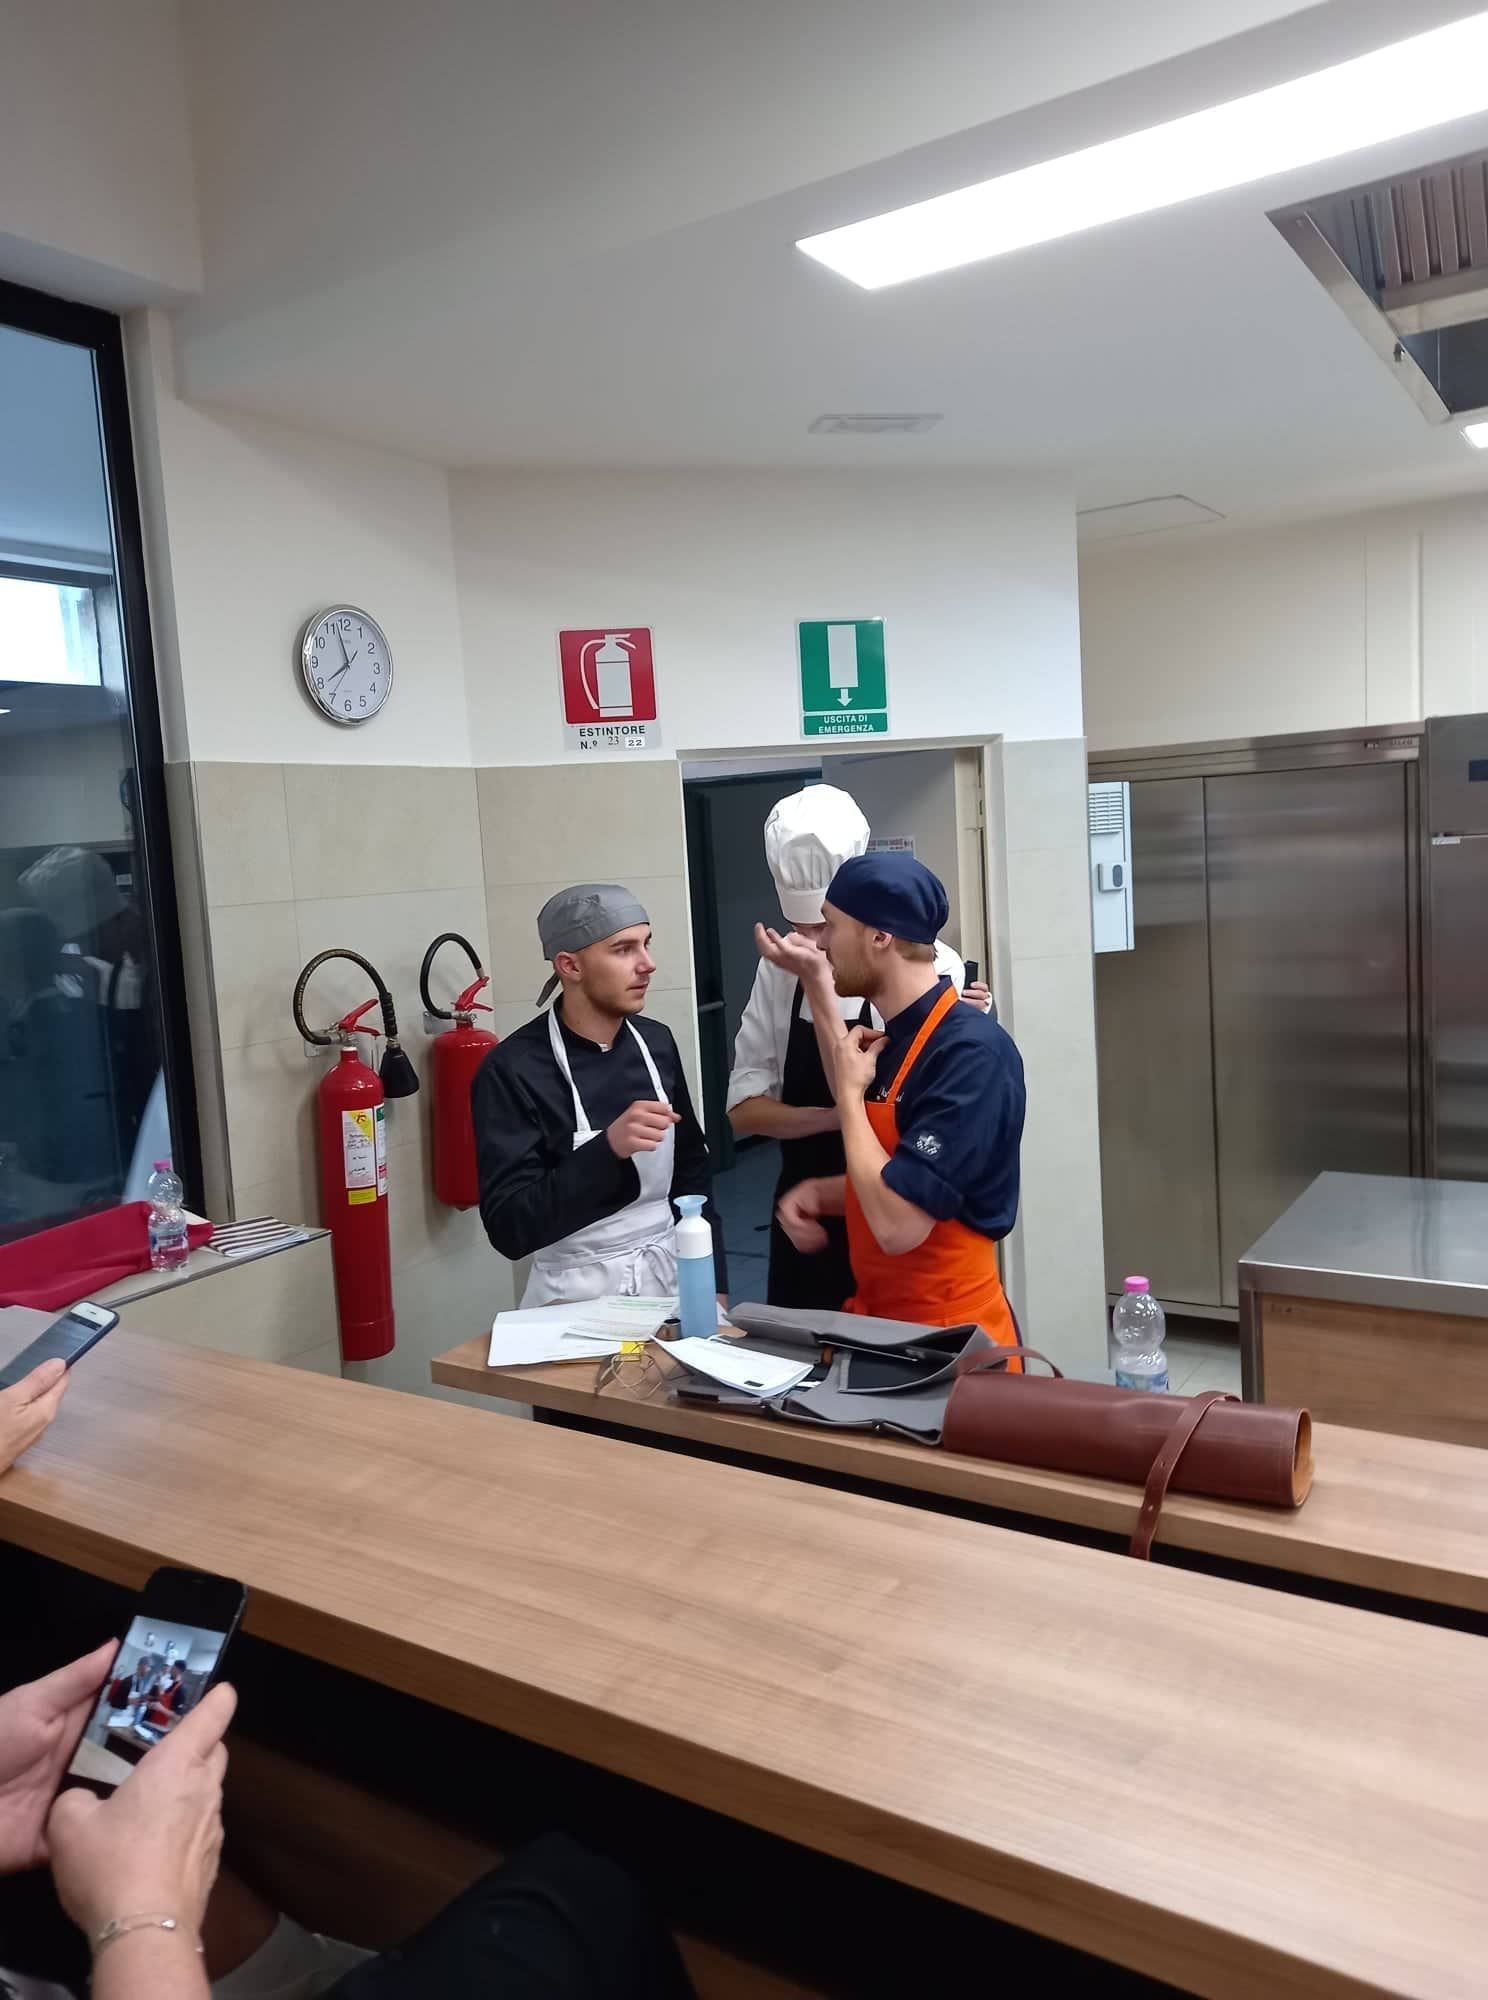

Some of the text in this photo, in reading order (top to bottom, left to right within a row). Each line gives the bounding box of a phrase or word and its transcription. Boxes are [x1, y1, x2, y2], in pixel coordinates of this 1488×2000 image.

[324, 622, 336, 635] 11
[339, 618, 352, 632] 12
[357, 626, 363, 639] 1
[314, 636, 326, 649] 10
[367, 642, 376, 655] 2
[311, 655, 319, 669] 9
[373, 663, 380, 674] 3
[316, 677, 325, 690] 8
[369, 682, 377, 695] 4
[328, 692, 337, 705] 7
[359, 695, 367, 708] 5
[344, 699, 352, 712] 6
[823, 714, 868, 724] USCITA DI
[580, 725, 645, 737] ESTINTORE
[818, 724, 874, 734] EMERGENZA
[628, 739, 642, 747] 22
